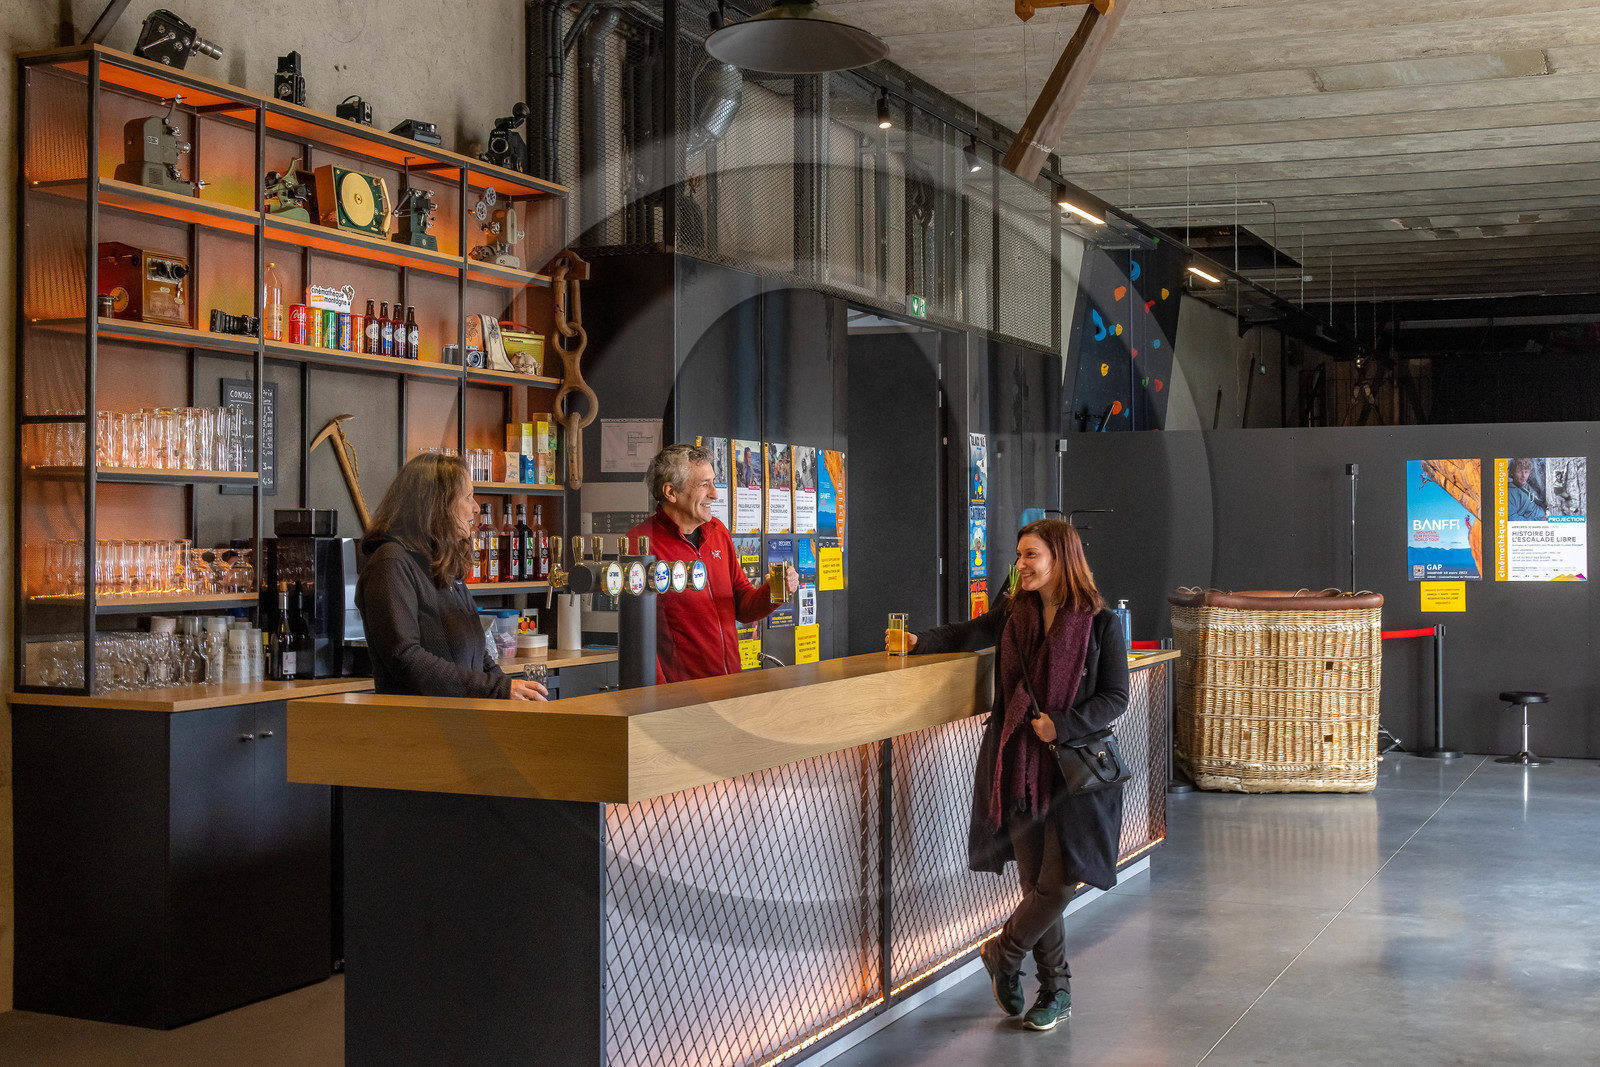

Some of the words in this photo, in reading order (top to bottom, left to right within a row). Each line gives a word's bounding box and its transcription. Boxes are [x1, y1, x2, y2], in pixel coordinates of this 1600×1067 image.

[311, 287, 344, 298] cinémathèque
[324, 296, 347, 306] montagne
[230, 390, 252, 400] CONSOS
[1498, 462, 1506, 504] montagne
[1498, 506, 1504, 516] de
[1498, 519, 1506, 578] cinémathèque
